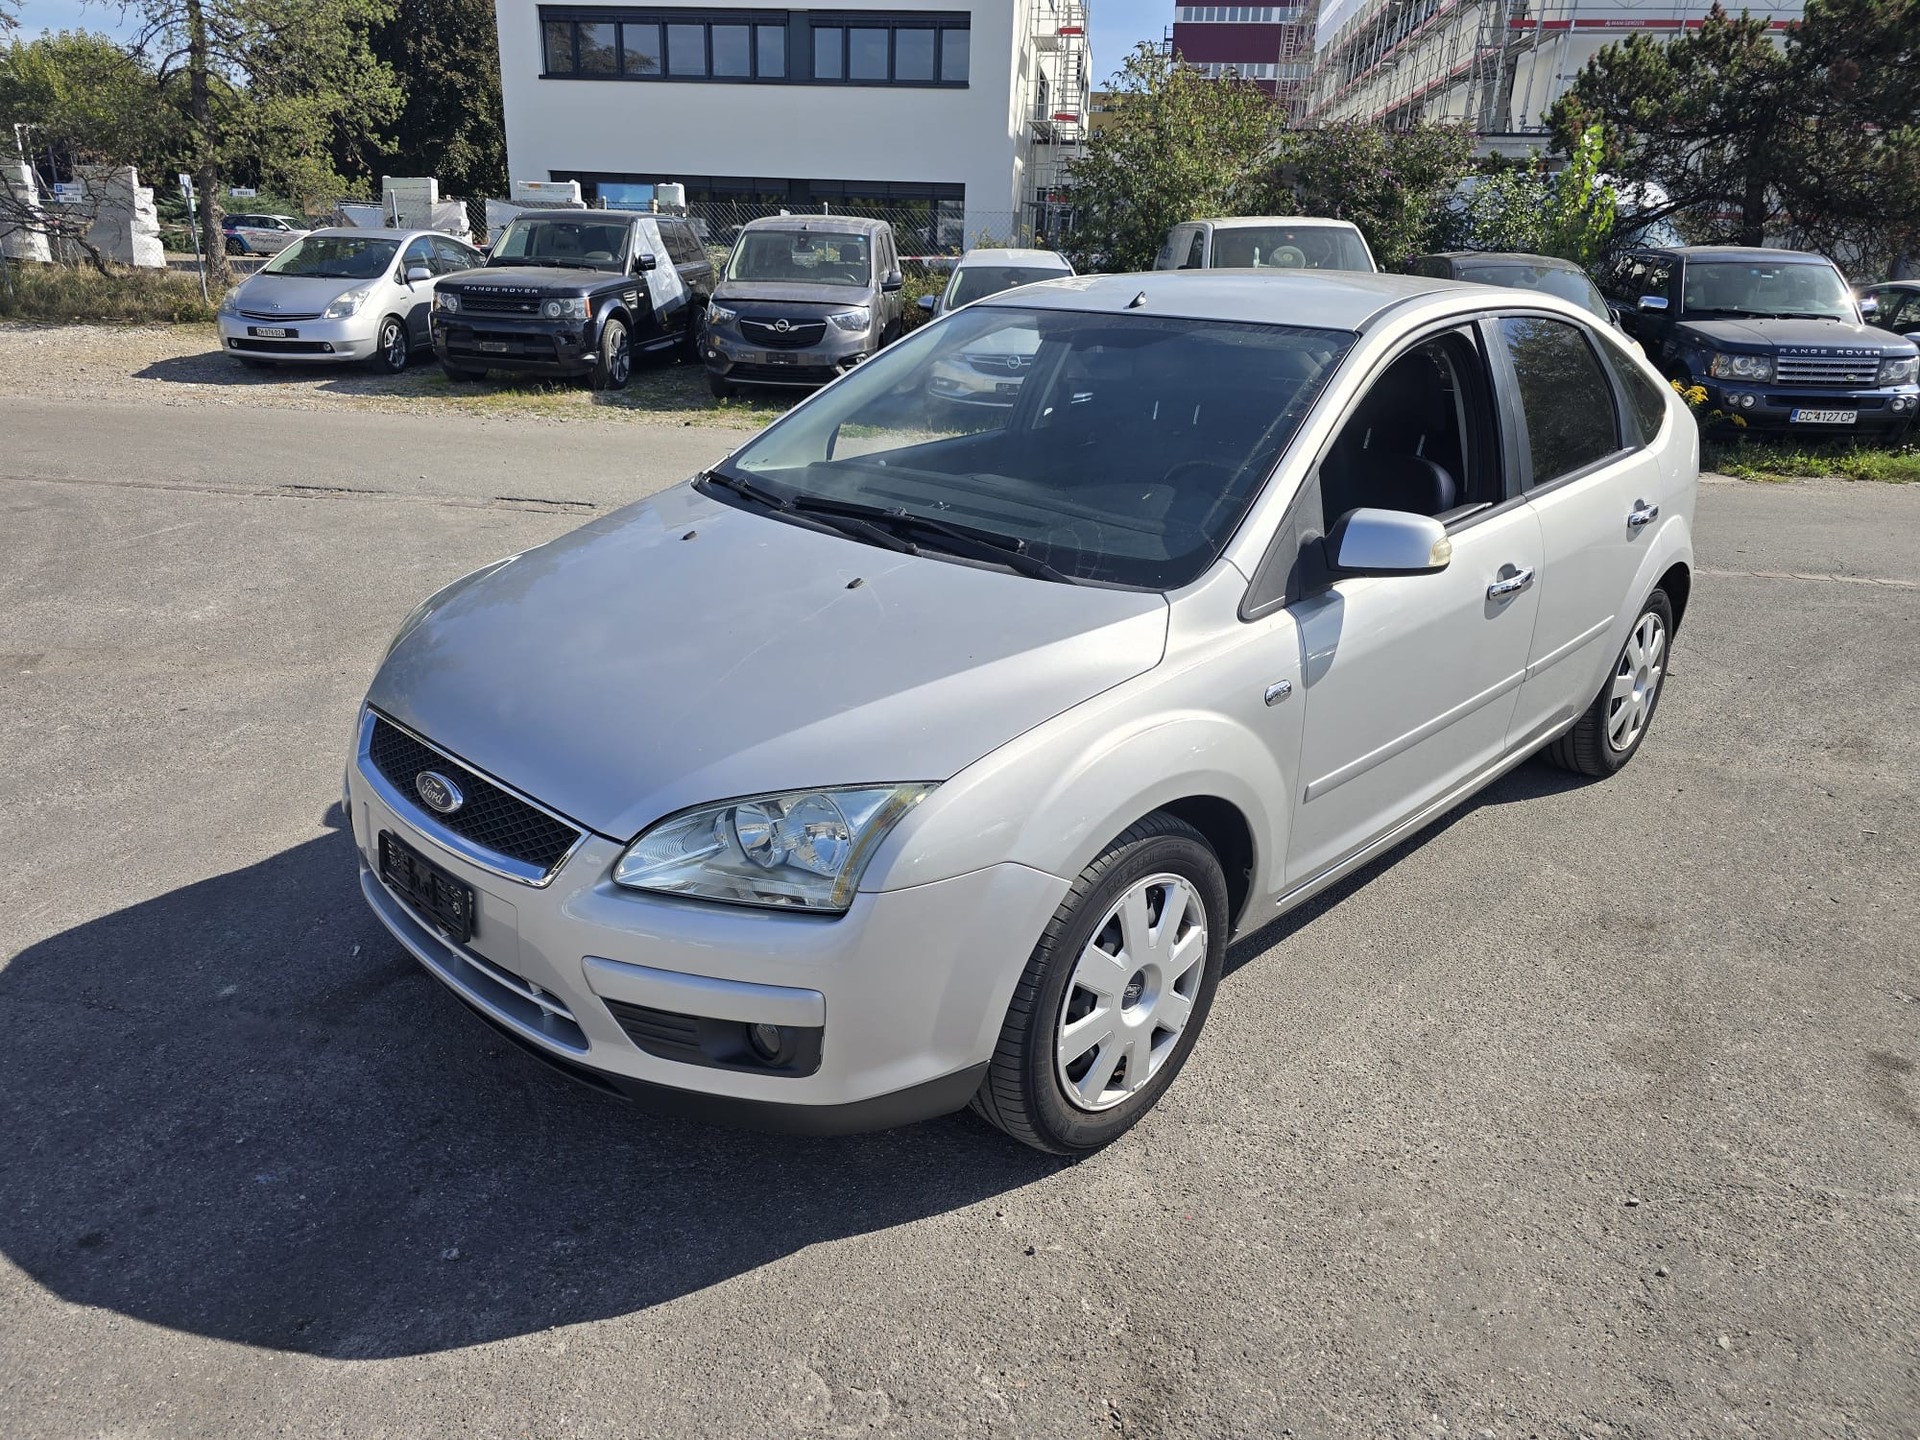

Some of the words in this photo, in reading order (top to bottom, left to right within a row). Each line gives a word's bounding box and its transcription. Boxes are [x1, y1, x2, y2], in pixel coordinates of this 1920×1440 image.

[463, 285, 499, 293] RANGE
[1779, 347, 1828, 355] RANGE
[422, 778, 445, 805] Ford
